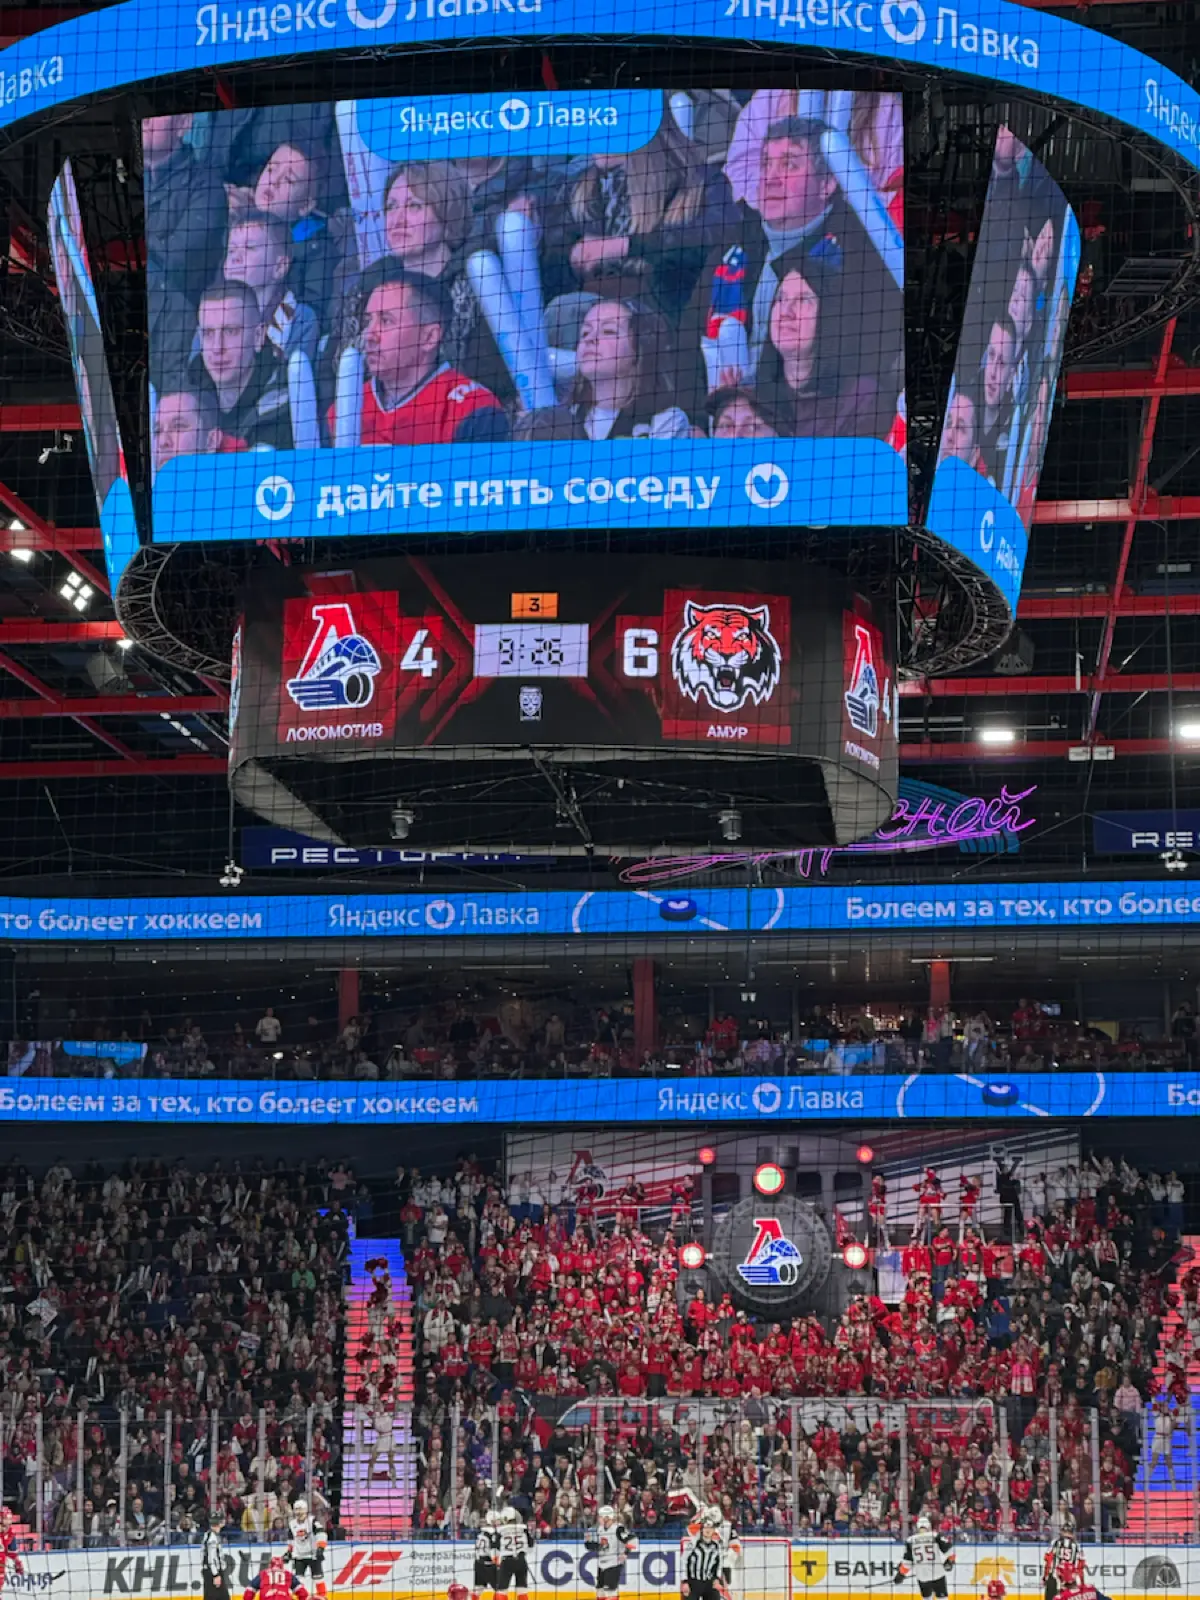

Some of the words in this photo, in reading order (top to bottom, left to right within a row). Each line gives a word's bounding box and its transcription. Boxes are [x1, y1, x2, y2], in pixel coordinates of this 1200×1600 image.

[194, 0, 338, 46] Яндекс
[932, 7, 1039, 69] Лавка
[400, 106, 494, 135] Яндекс
[536, 101, 618, 128] Лавка
[1145, 78, 1200, 152] Яндек
[316, 473, 443, 518] дайте
[453, 476, 553, 507] пять
[563, 475, 720, 511] соседу
[529, 598, 540, 612] 3
[400, 629, 438, 678] 4
[499, 638, 564, 665] 9:26
[623, 628, 659, 678] 6
[286, 722, 384, 742] ЛОКОМОТИВ
[706, 724, 749, 739] АМУР
[1131, 831, 1200, 848] RE
[38, 908, 138, 932] болеет
[144, 911, 263, 930] хоккеем
[328, 903, 420, 930] Яндекс
[460, 902, 540, 926] Лавка
[847, 897, 956, 919] Болеем
[963, 901, 994, 918] за
[1000, 899, 1056, 919] тех,
[1063, 898, 1112, 917] кто
[0, 1088, 105, 1112] Болеем
[112, 1096, 141, 1112] за
[148, 1096, 201, 1115] тех,
[207, 1096, 254, 1113] кто
[259, 1091, 357, 1114] болеет
[362, 1096, 478, 1114] хоккеем
[658, 1087, 748, 1114] Яндекс
[787, 1085, 864, 1109] Лавка
[503, 1535, 525, 1551] 25
[912, 1545, 936, 1564] 55
[266, 1570, 286, 1586] 10
